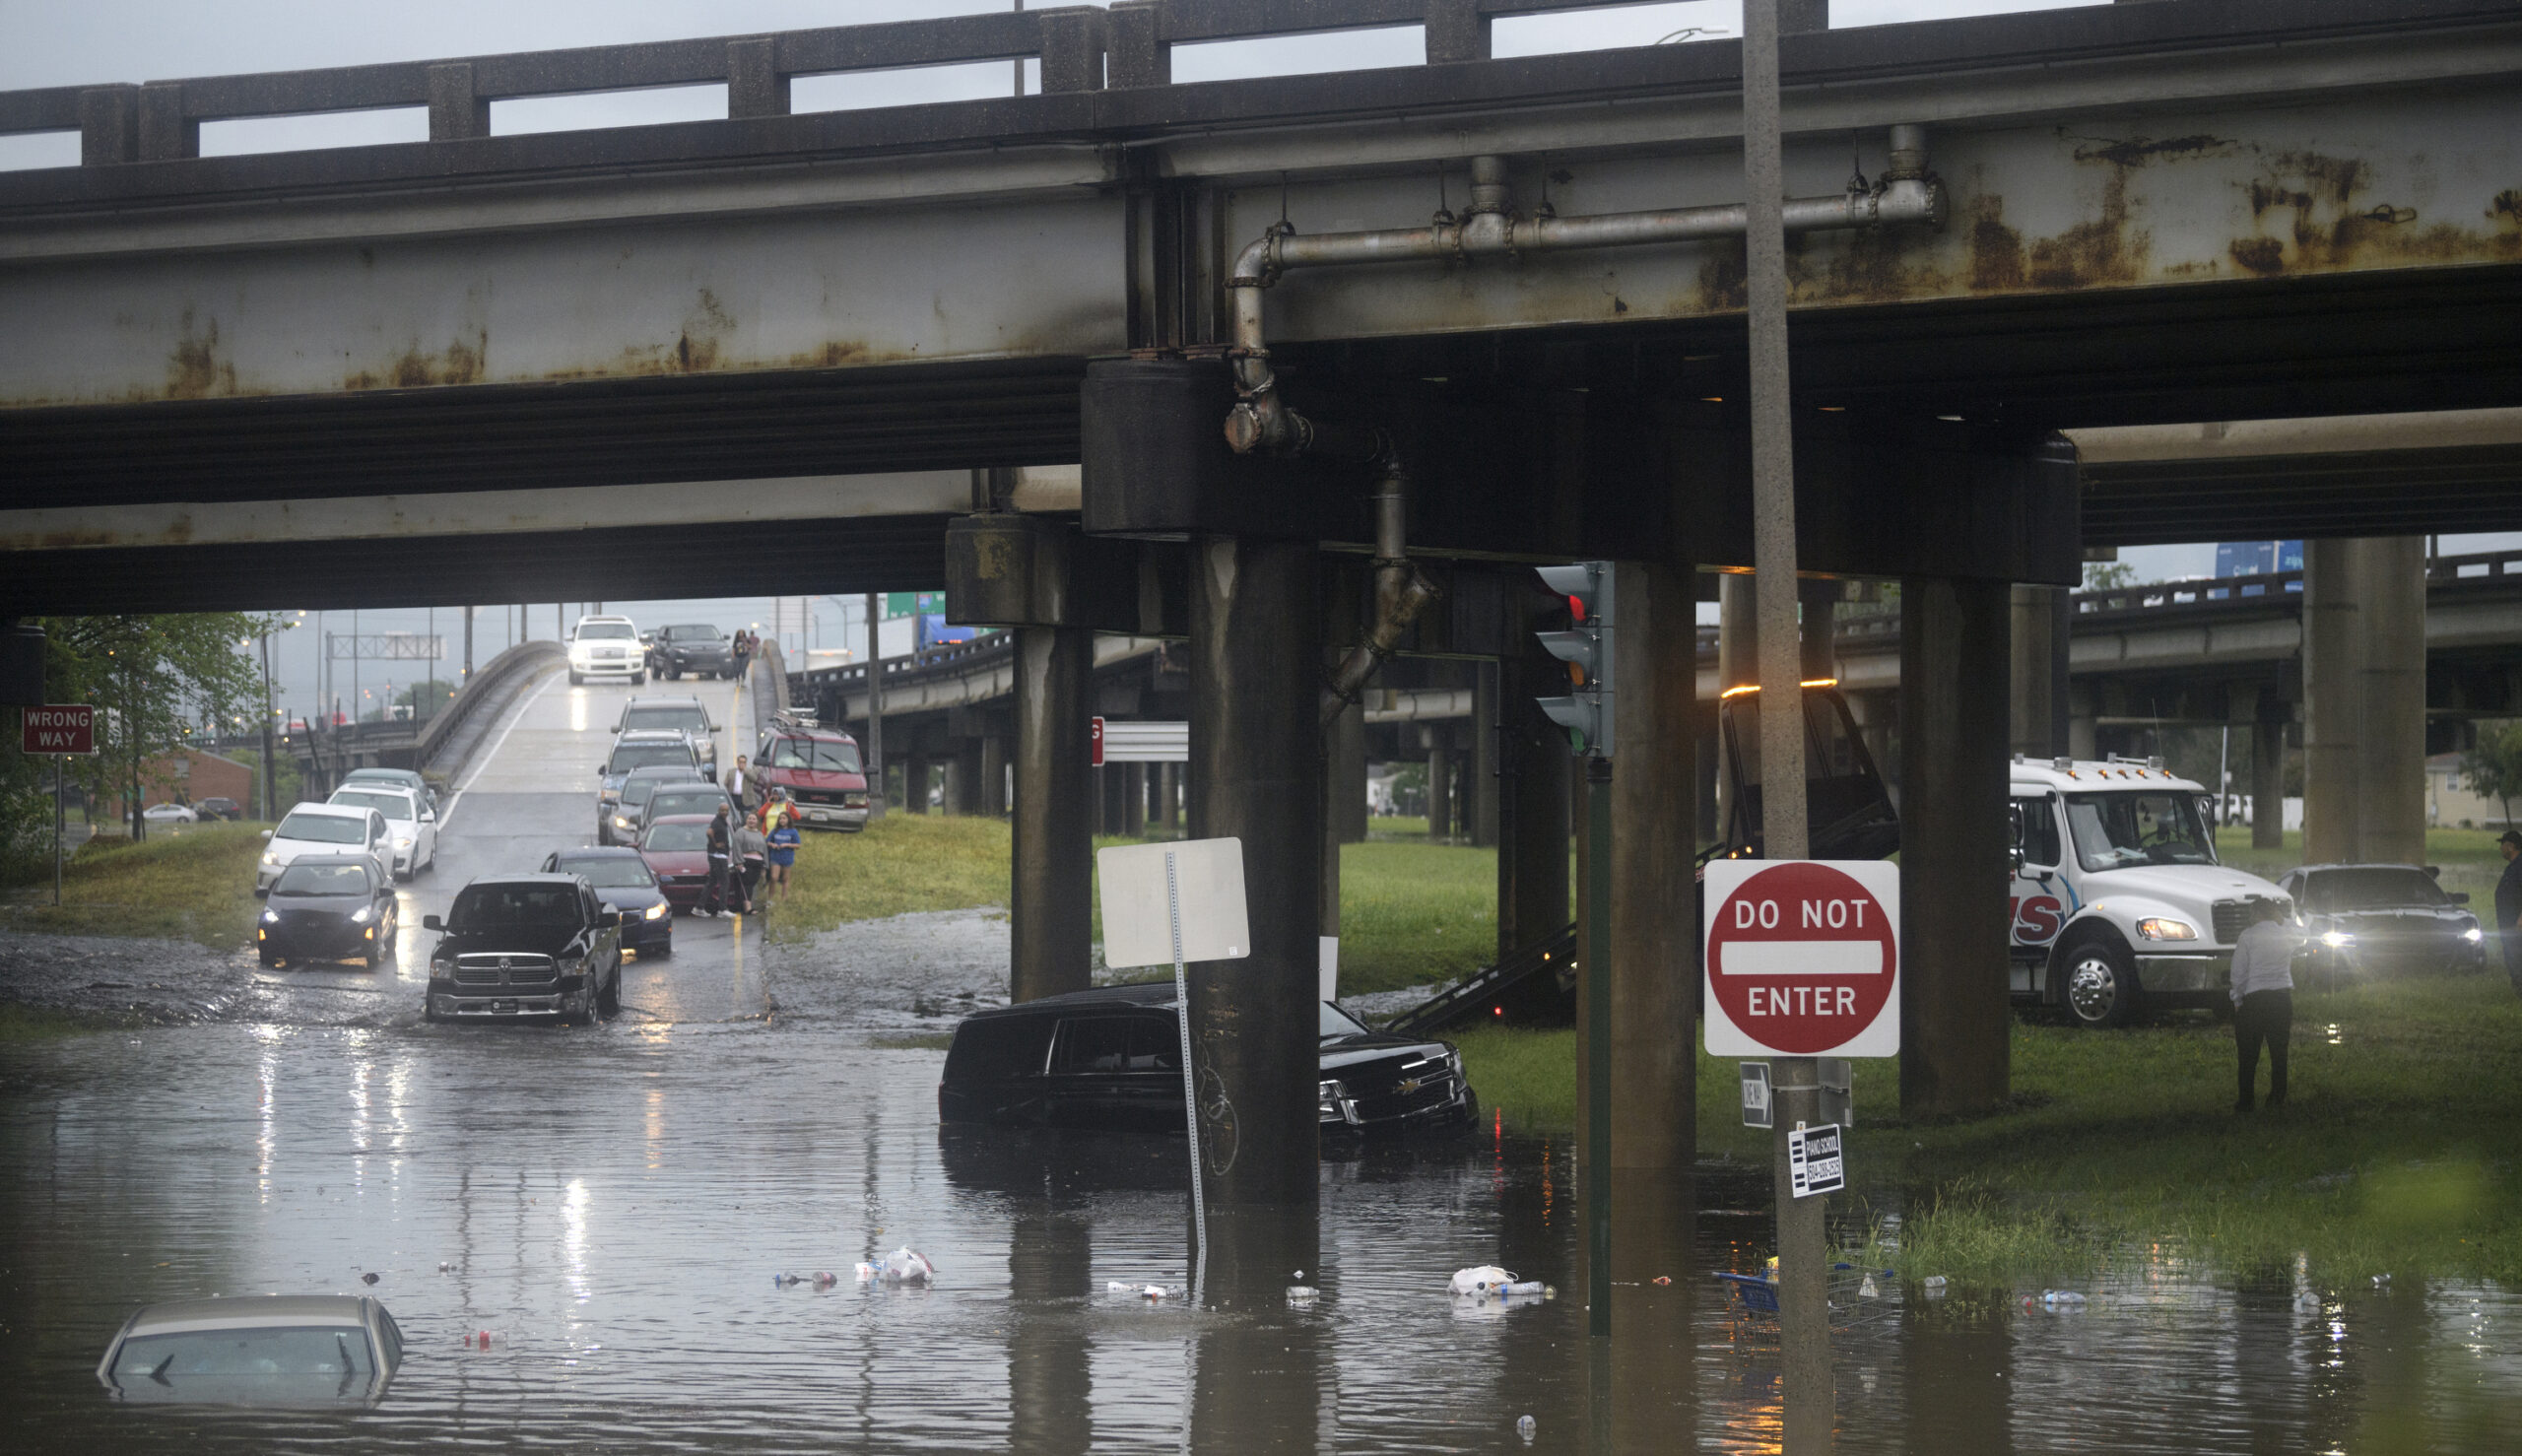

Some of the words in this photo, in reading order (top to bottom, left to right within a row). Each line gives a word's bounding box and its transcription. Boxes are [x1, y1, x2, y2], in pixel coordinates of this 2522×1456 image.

[28, 711, 89, 727] WRONG
[39, 731, 76, 747] WAY
[1735, 899, 1779, 929] DO
[1802, 898, 1869, 928] NOT
[1749, 987, 1856, 1016] ENTER
[1806, 1139, 1821, 1157] PIANO
[1821, 1135, 1838, 1154] SCHOOL
